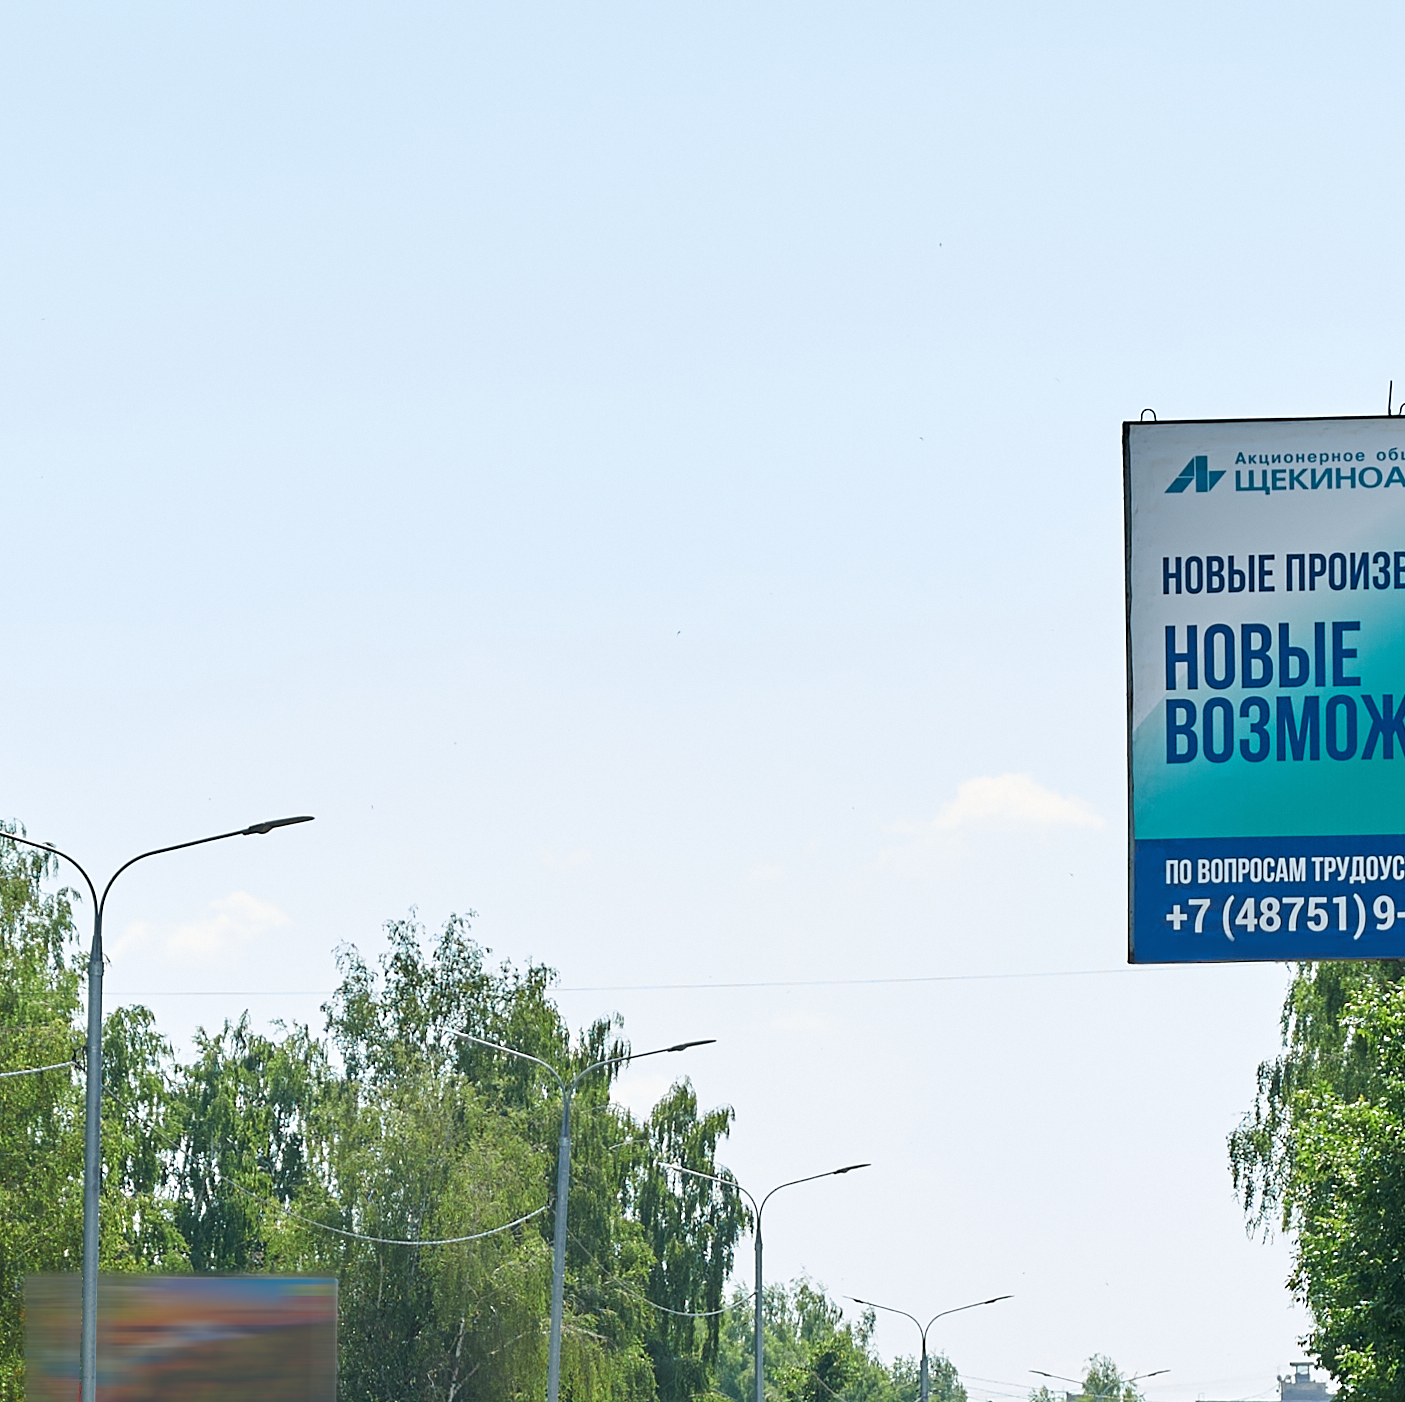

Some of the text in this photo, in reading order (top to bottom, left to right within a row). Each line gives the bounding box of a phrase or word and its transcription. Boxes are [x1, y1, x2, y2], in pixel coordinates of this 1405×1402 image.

[1235, 451, 1366, 466] Акционерное
[1162, 555, 1275, 595] НОВЫЕ
[1165, 621, 1362, 691] НОВЫЕ
[1165, 859, 1192, 885] ПО
[1198, 857, 1306, 884] ВОПРОСАМ
[1166, 898, 1211, 933] +7
